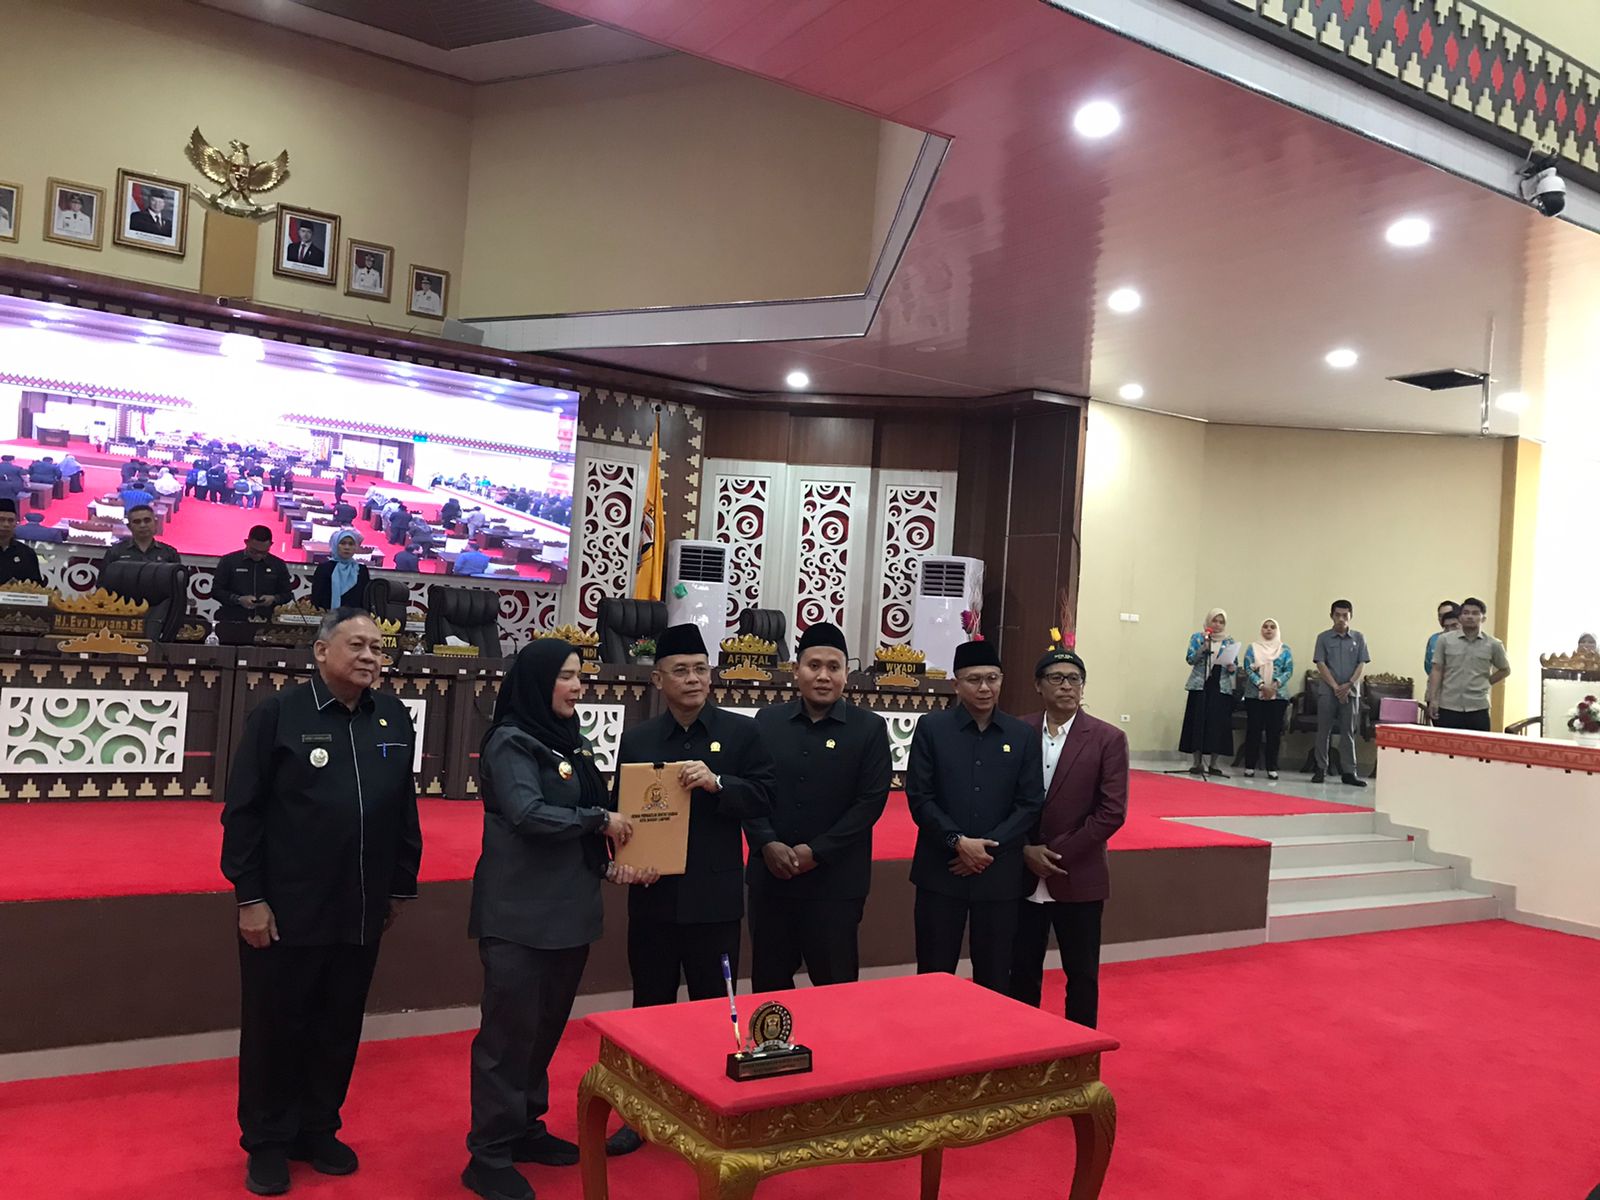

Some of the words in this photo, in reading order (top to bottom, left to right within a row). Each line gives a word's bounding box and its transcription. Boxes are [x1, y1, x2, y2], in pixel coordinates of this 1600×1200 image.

[130, 618, 145, 631] SE
[727, 654, 771, 665] AFRIZAL
[886, 662, 916, 673] WIYADI
